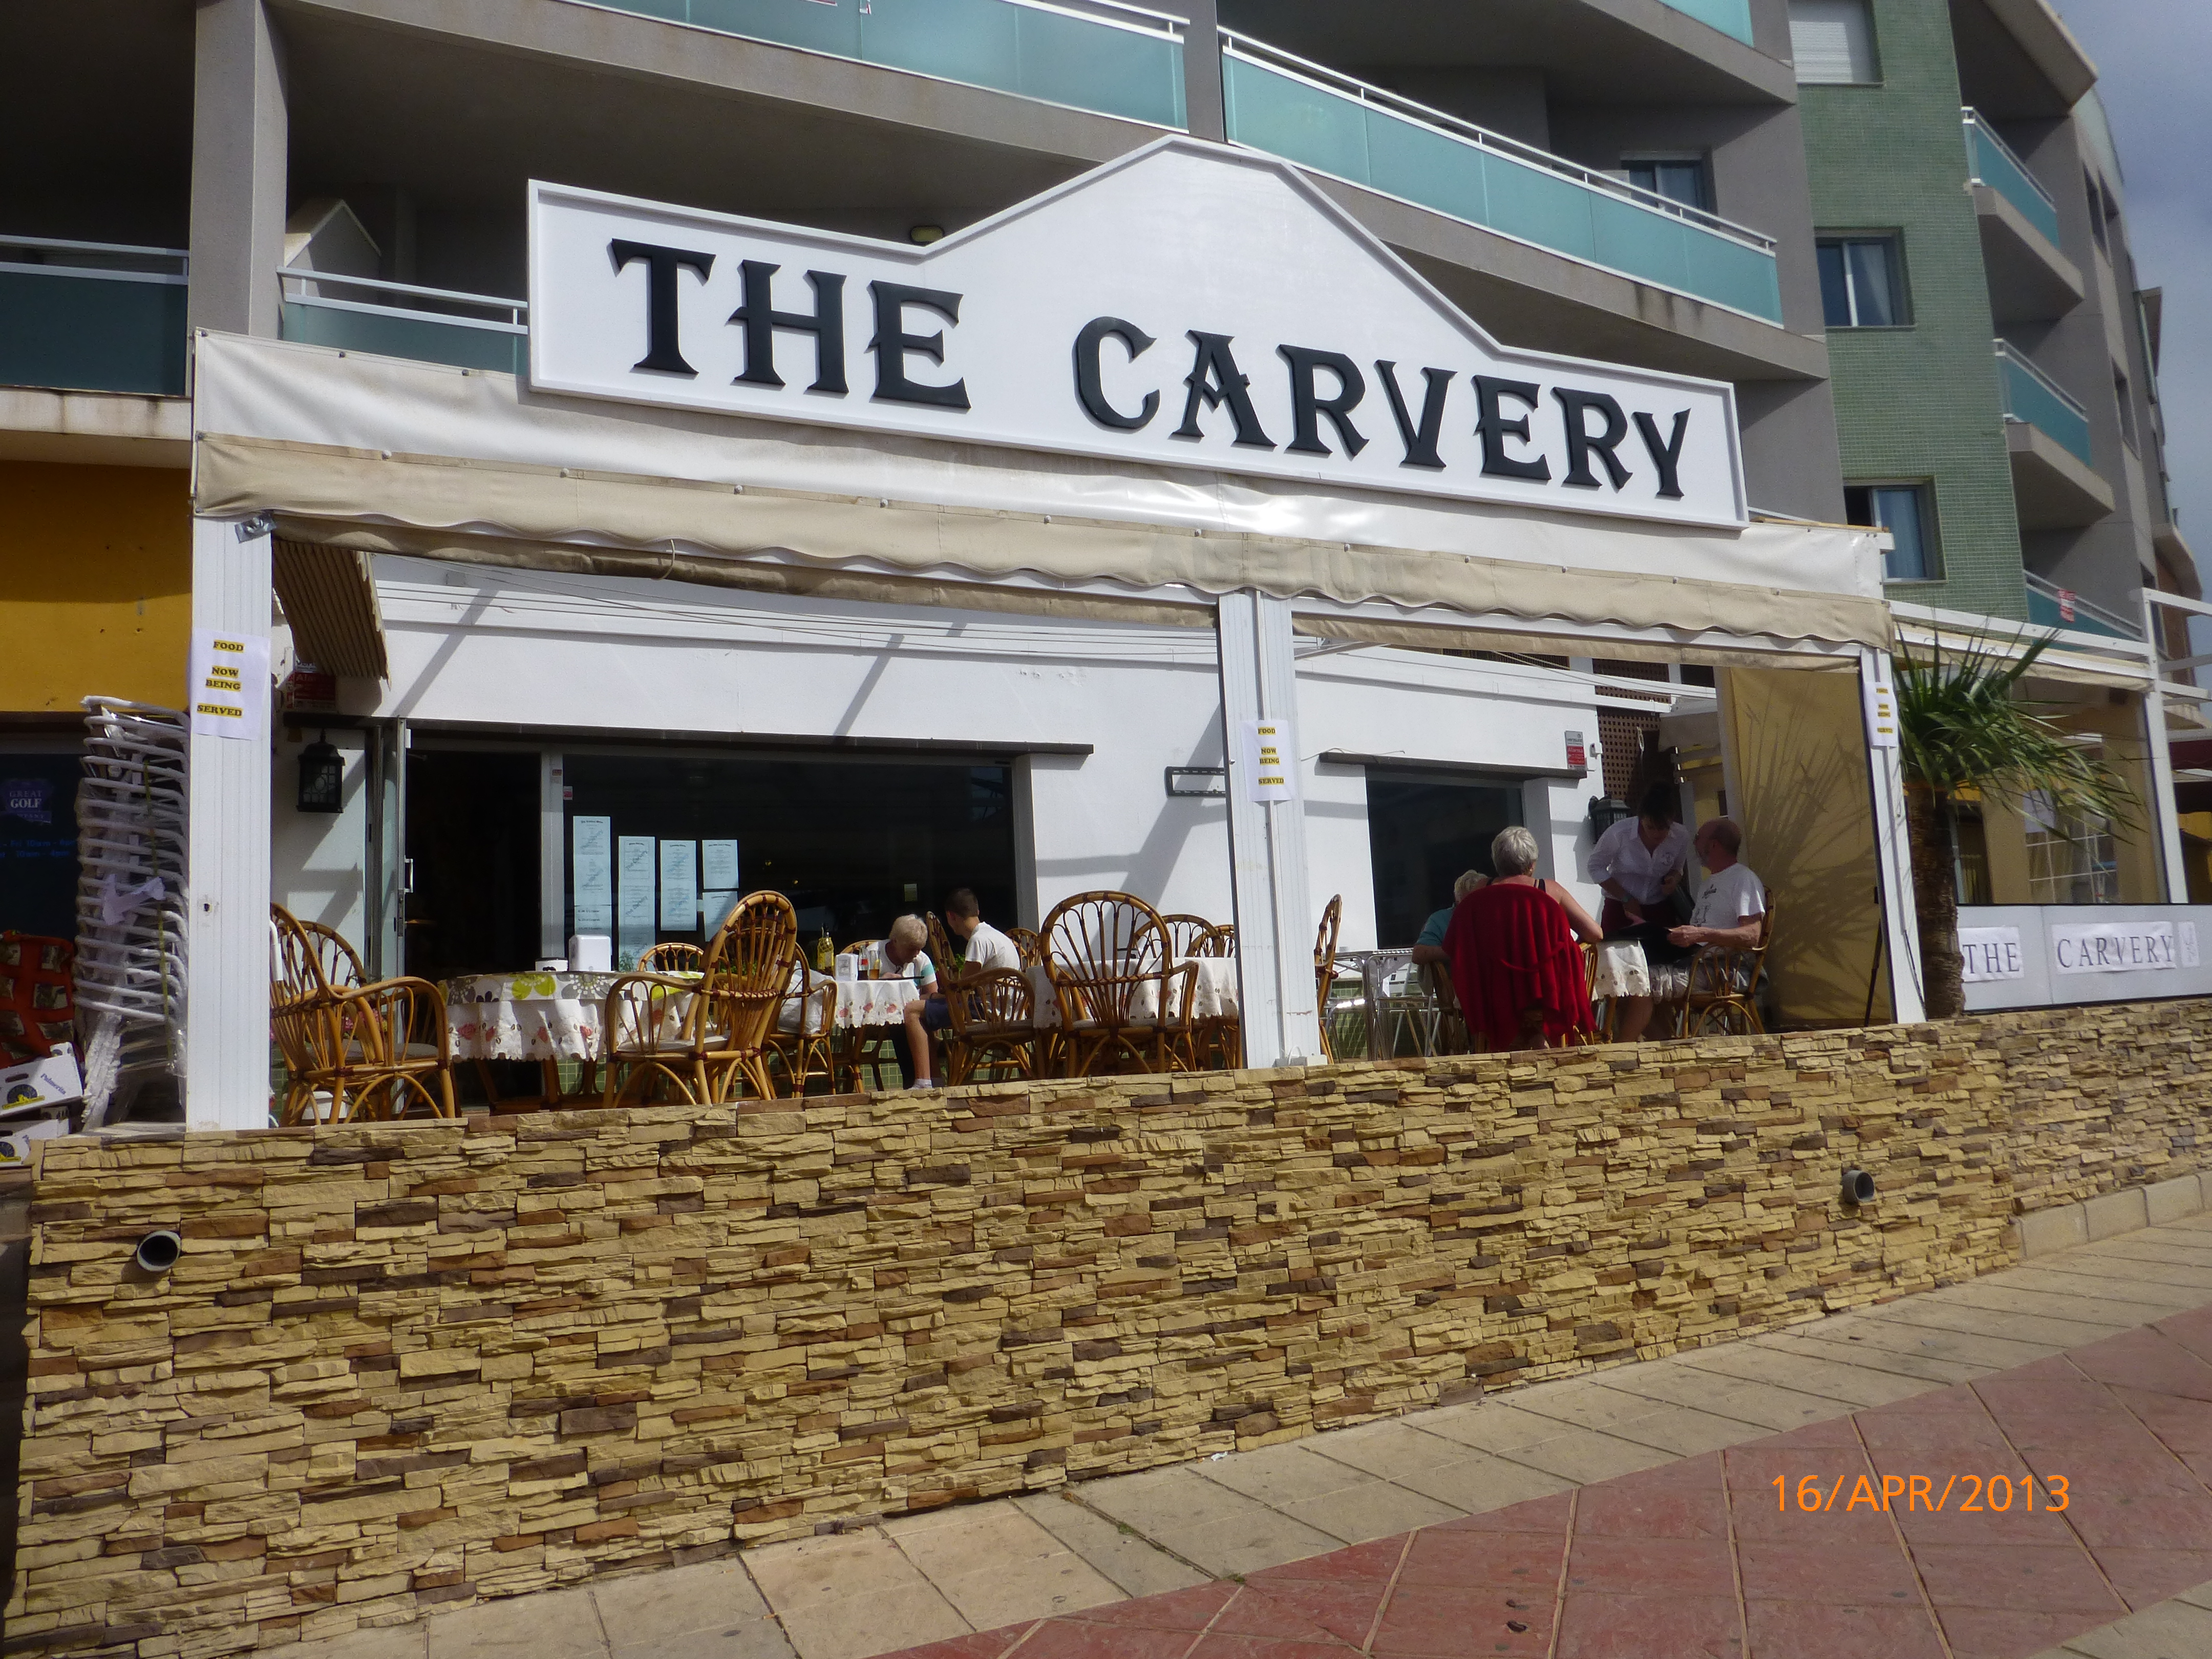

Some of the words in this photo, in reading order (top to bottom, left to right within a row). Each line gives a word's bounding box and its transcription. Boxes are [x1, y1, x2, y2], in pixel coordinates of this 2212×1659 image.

[610, 238, 970, 410] THE
[1072, 316, 1692, 499] CARVERY
[213, 641, 244, 651] FOOD
[211, 667, 239, 676] NOW
[206, 679, 241, 690] BEING
[197, 705, 242, 716] SERVED
[10, 798, 42, 809] GOLF
[1963, 942, 2020, 974] THE
[2057, 935, 2173, 968] CARVERY
